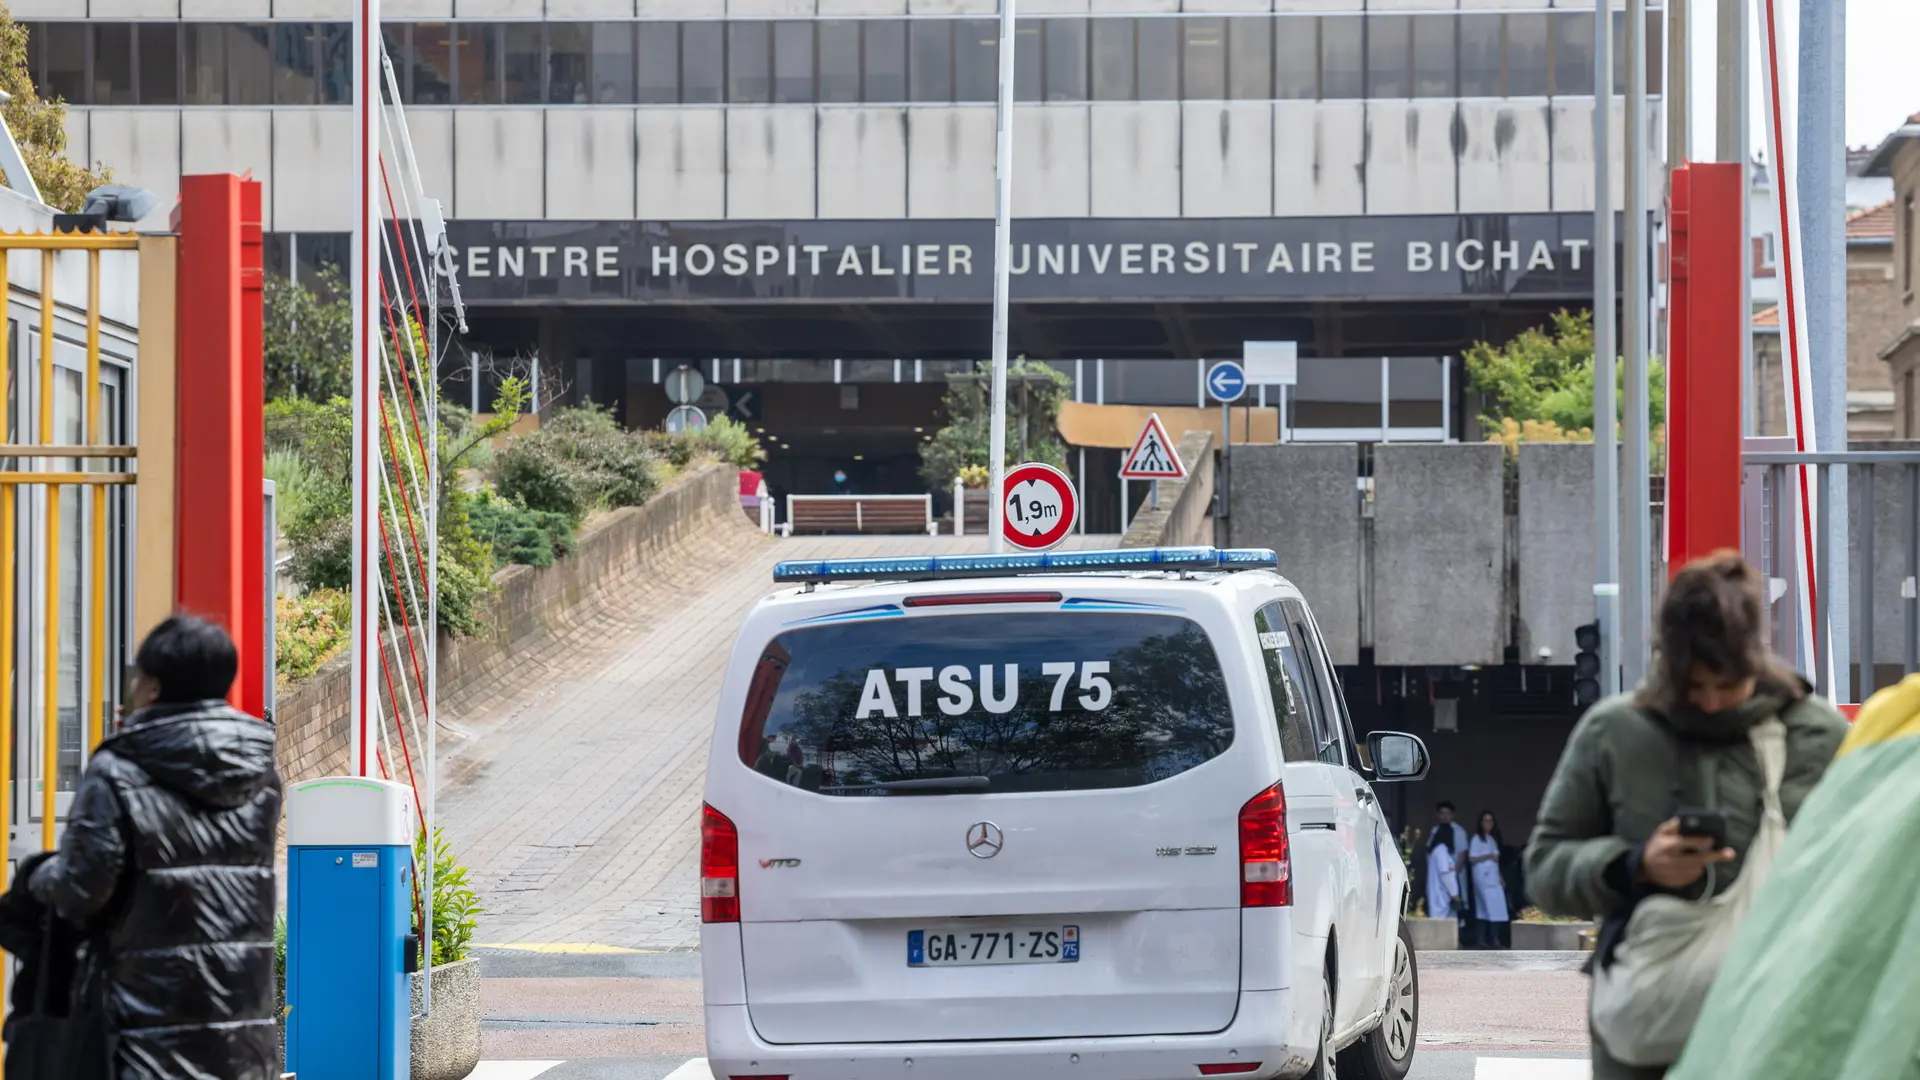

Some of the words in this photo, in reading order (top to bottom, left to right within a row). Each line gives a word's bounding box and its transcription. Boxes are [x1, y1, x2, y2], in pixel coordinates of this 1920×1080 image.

[436, 245, 620, 277] CENTRE
[651, 243, 973, 277] HOSPITALIER
[1008, 241, 1376, 275] UNIVERSITAIRE
[1406, 238, 1590, 272] BICHAT
[1009, 493, 1058, 524] 1,9m
[855, 663, 1019, 719] ATSU
[1041, 660, 1113, 712] 75
[757, 857, 802, 869] VITO
[928, 931, 1059, 961] GA-771-ZS
[1063, 944, 1077, 956] 75
